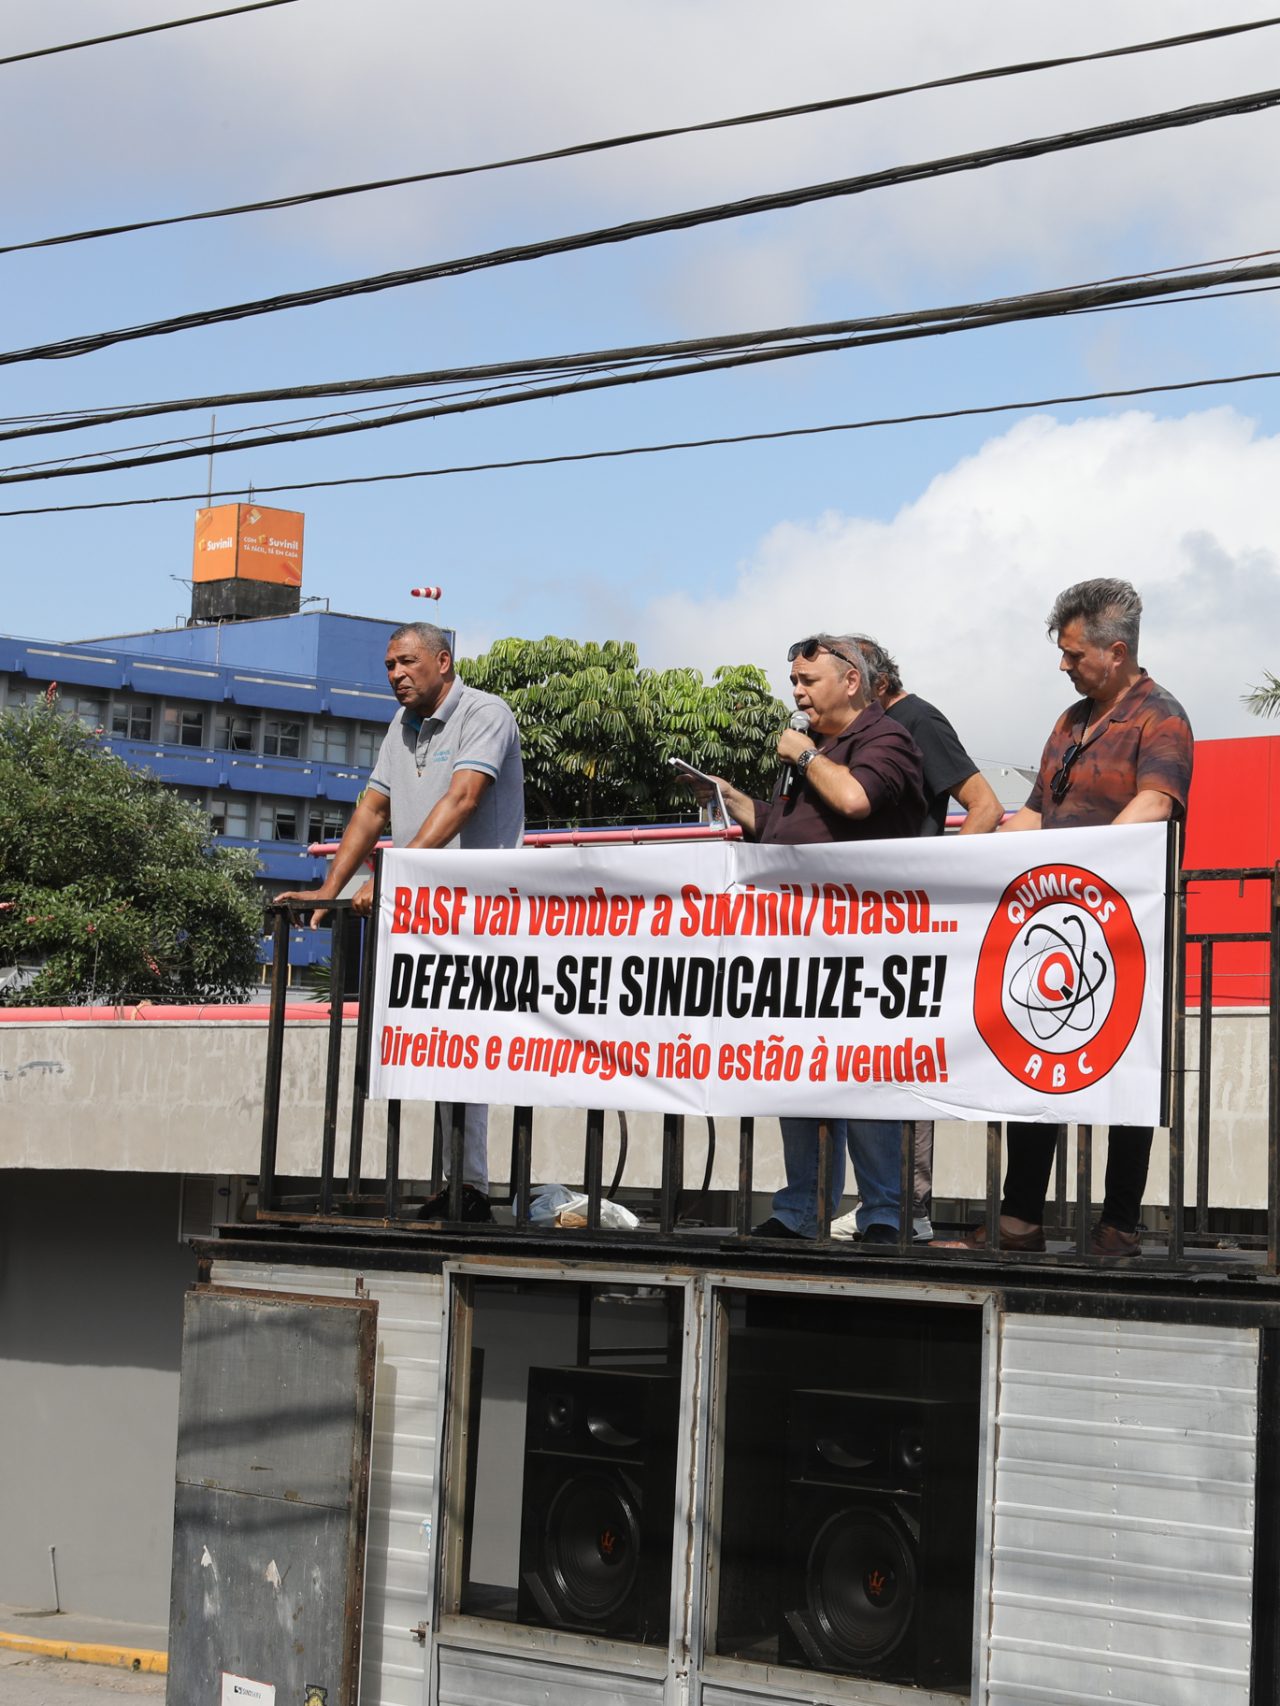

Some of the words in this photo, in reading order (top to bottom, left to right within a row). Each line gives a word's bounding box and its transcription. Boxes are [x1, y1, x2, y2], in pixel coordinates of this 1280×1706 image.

[207, 536, 233, 551] Suvinil
[269, 537, 299, 550] Suvinil
[391, 886, 468, 935] BASF
[474, 887, 521, 936] vai
[528, 887, 645, 936] vender
[650, 894, 673, 936] a
[1007, 872, 1116, 924] QUÍMICOS
[388, 953, 612, 1015] DEFENDA-SE!
[619, 955, 947, 1019] SINDICALIZE-SE!
[381, 1026, 480, 1069] Direitos
[485, 1035, 502, 1070] e
[508, 1035, 650, 1081] empregos
[656, 1033, 711, 1080] não
[718, 1034, 804, 1082] estão
[809, 1036, 829, 1082] à
[836, 1037, 948, 1083] venda!
